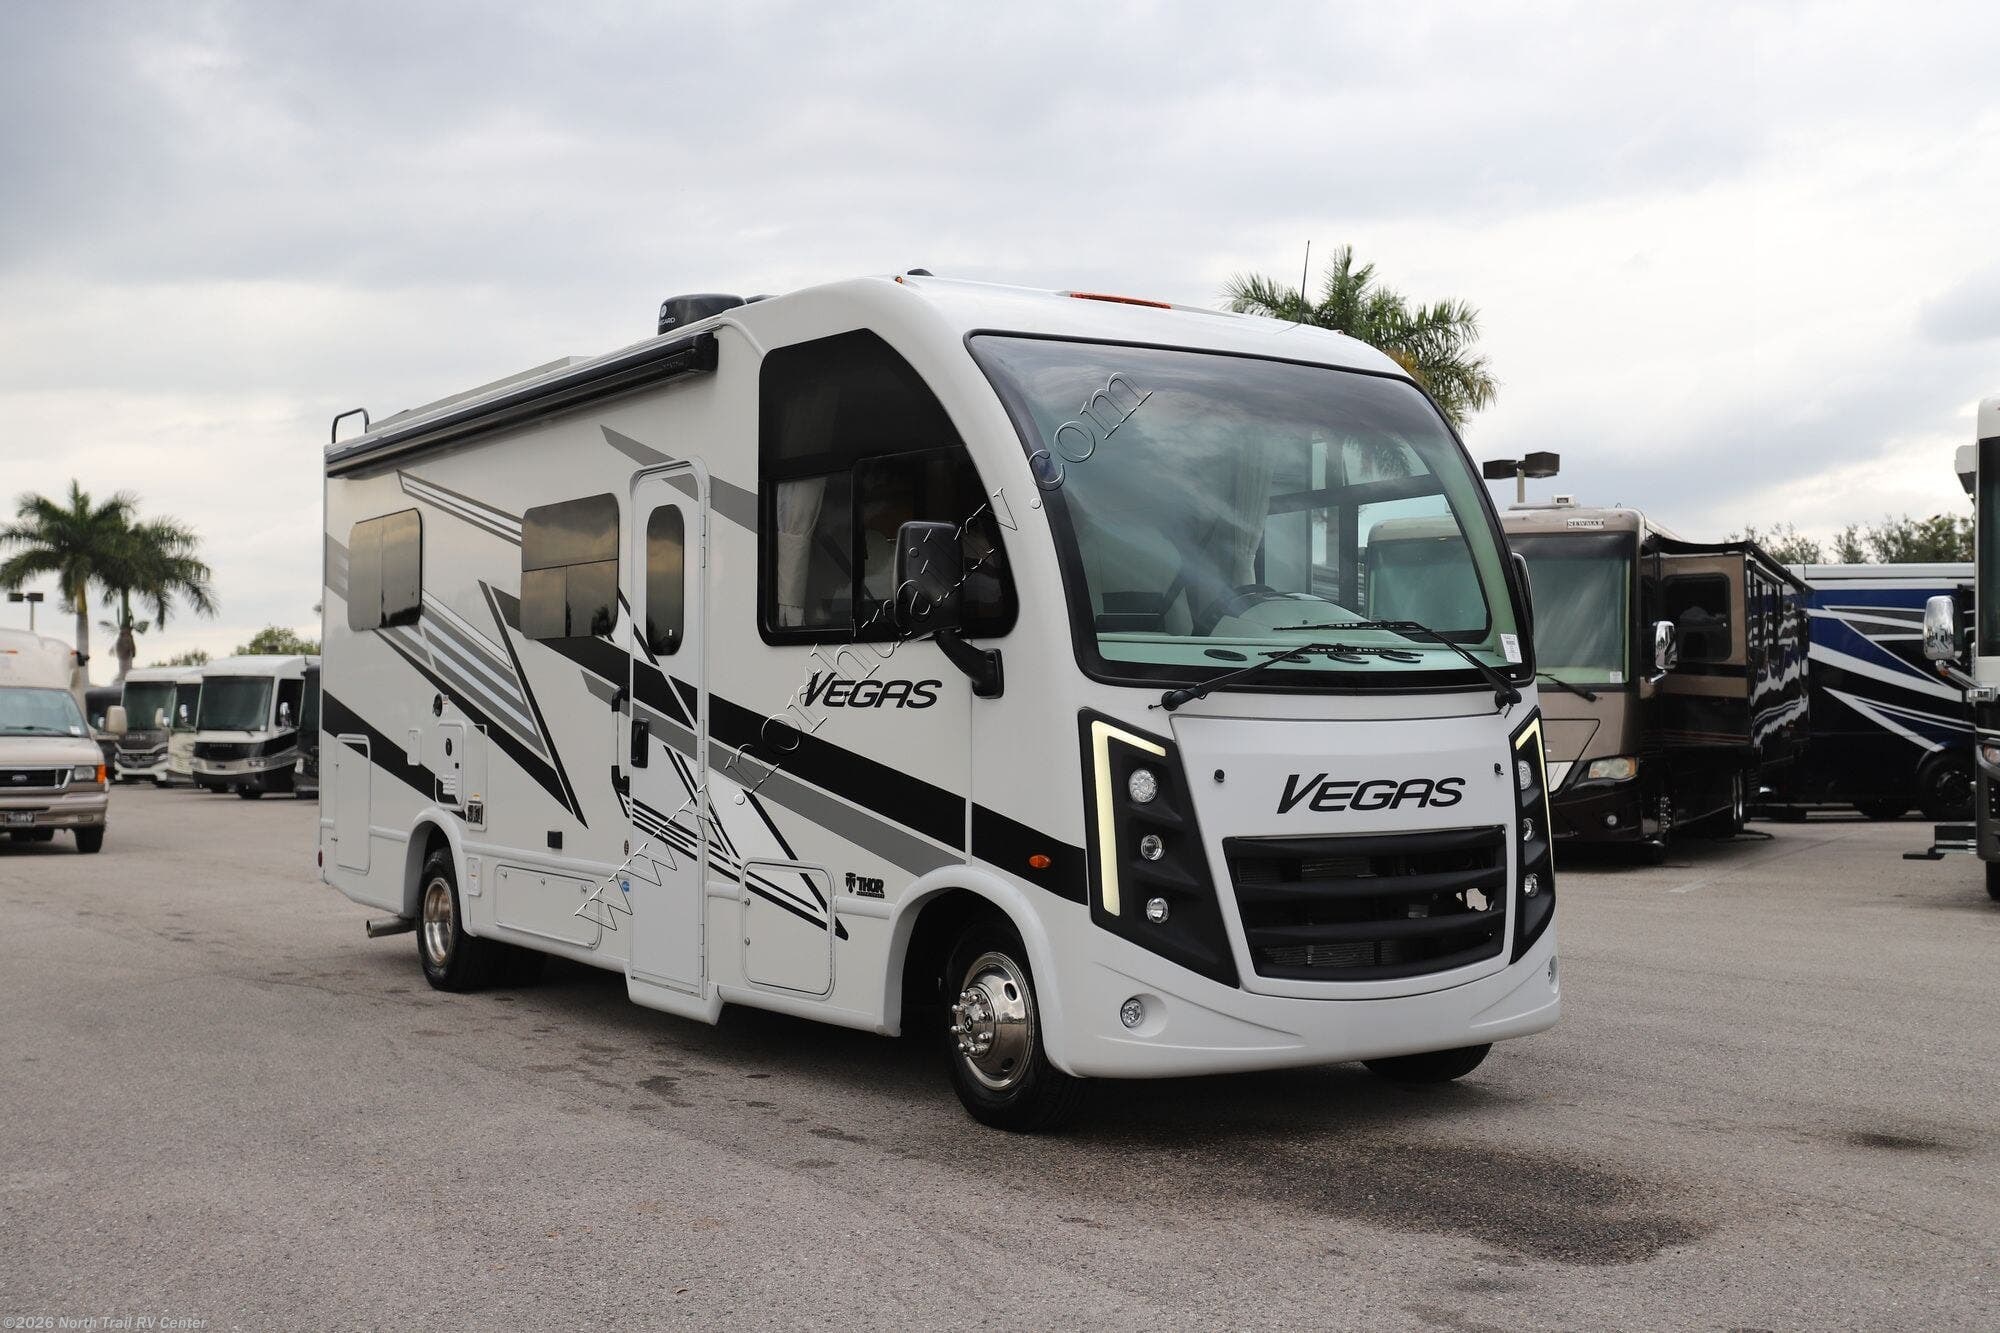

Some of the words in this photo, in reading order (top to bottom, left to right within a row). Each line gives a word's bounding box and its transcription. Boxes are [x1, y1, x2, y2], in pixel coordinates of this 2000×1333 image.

[804, 671, 942, 708] VEGAS
[1276, 773, 1466, 814] VEGAS
[857, 876, 885, 893] THOR
